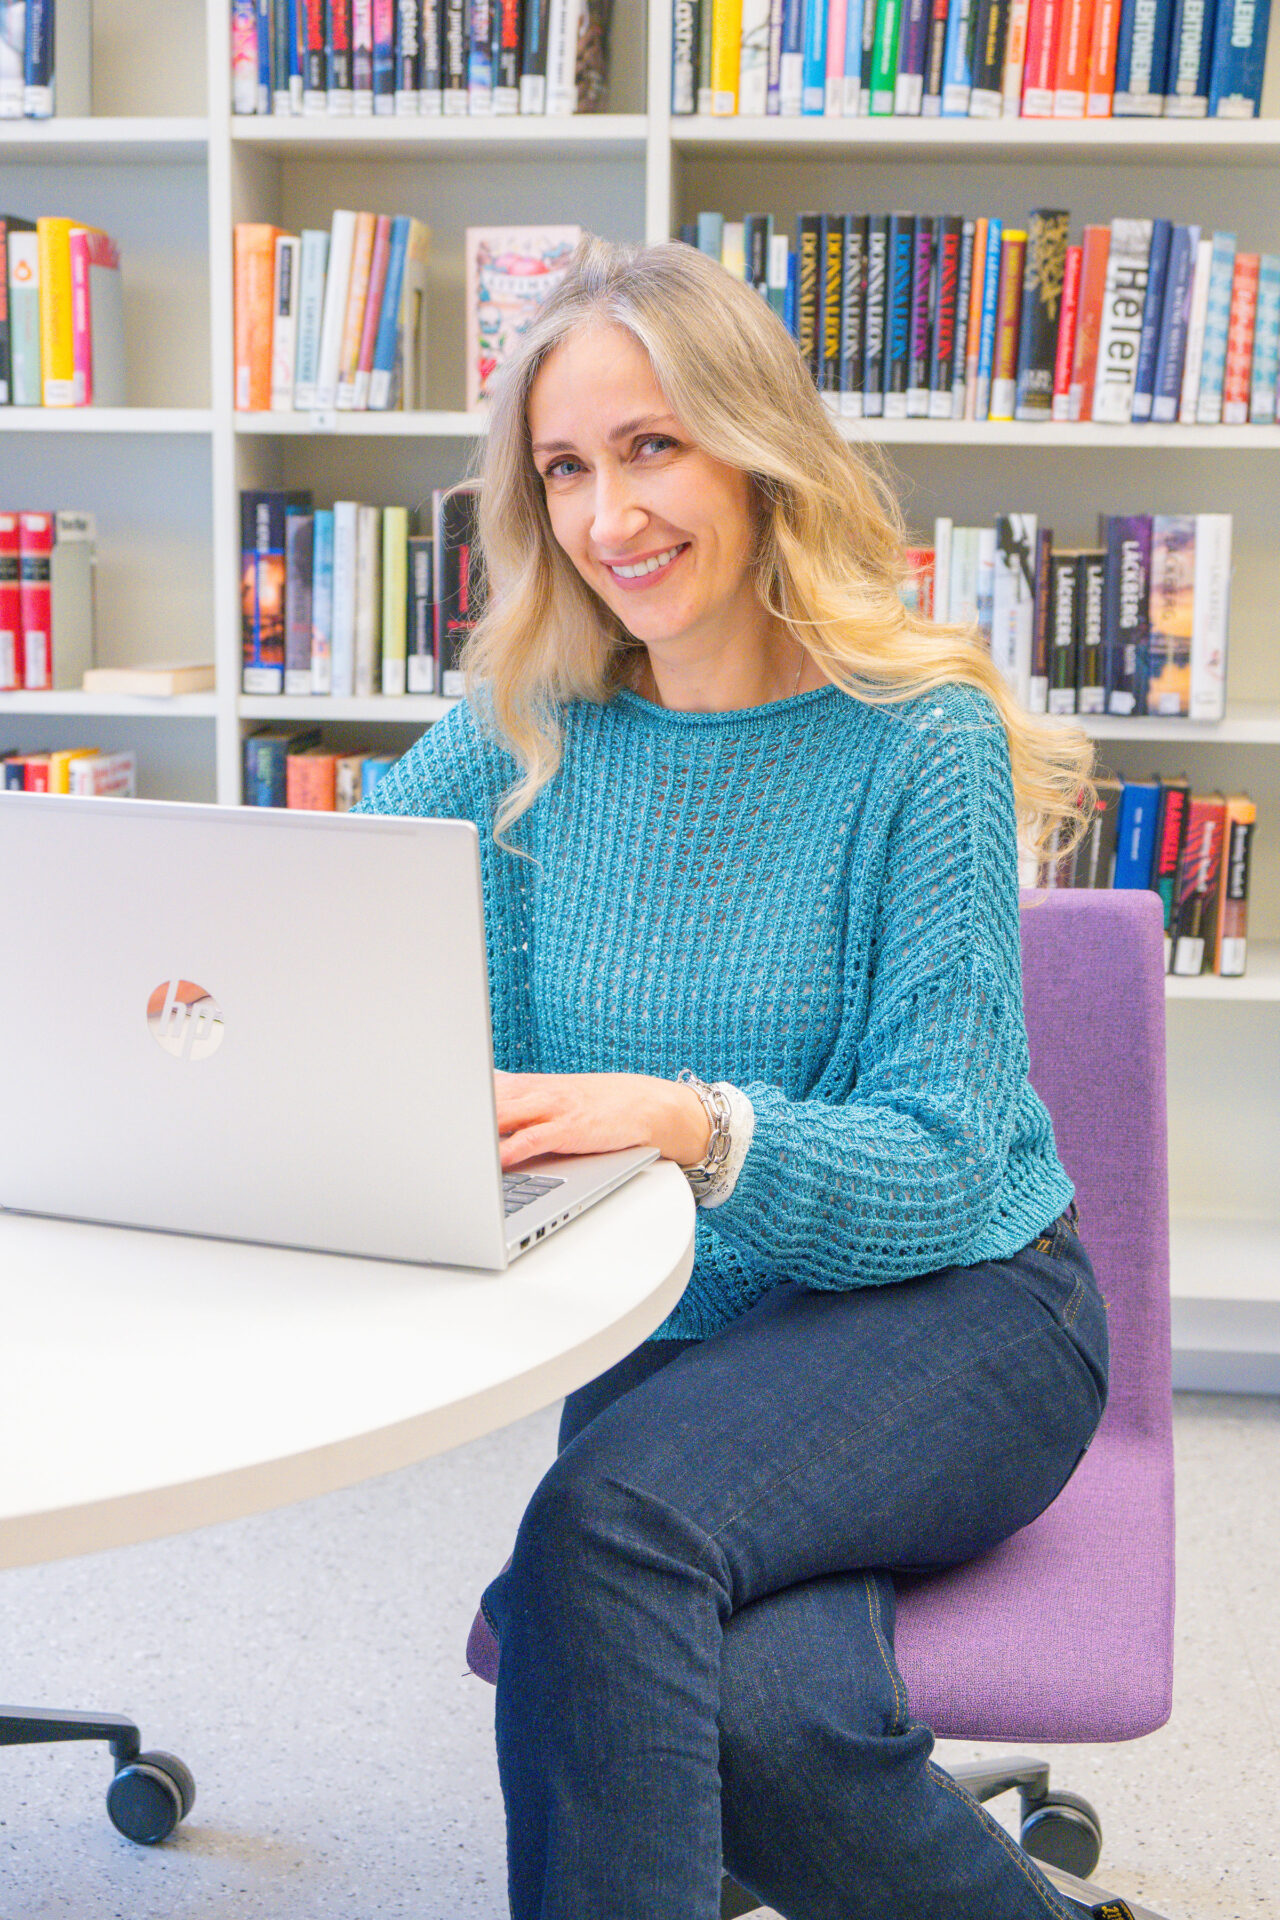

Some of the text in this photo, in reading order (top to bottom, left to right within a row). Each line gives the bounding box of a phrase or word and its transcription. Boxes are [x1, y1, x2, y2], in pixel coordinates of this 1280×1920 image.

[800, 232, 817, 305] DONNA
[824, 232, 842, 358] DONNA LEON
[844, 233, 861, 360] DONNA LEON
[867, 232, 886, 358] DONNA LEON
[891, 233, 911, 360] DONNA LEON
[913, 232, 932, 358] DONNA LEON
[938, 233, 959, 360] DONNA LEON
[1105, 267, 1148, 385] Helen
[1055, 566, 1075, 646] LÄCKBERG
[1085, 565, 1103, 645] LÄCKBERG
[1120, 540, 1142, 628] LÄCKBERG
[1159, 791, 1184, 875] MANKELL
[158, 980, 214, 1062] hp
